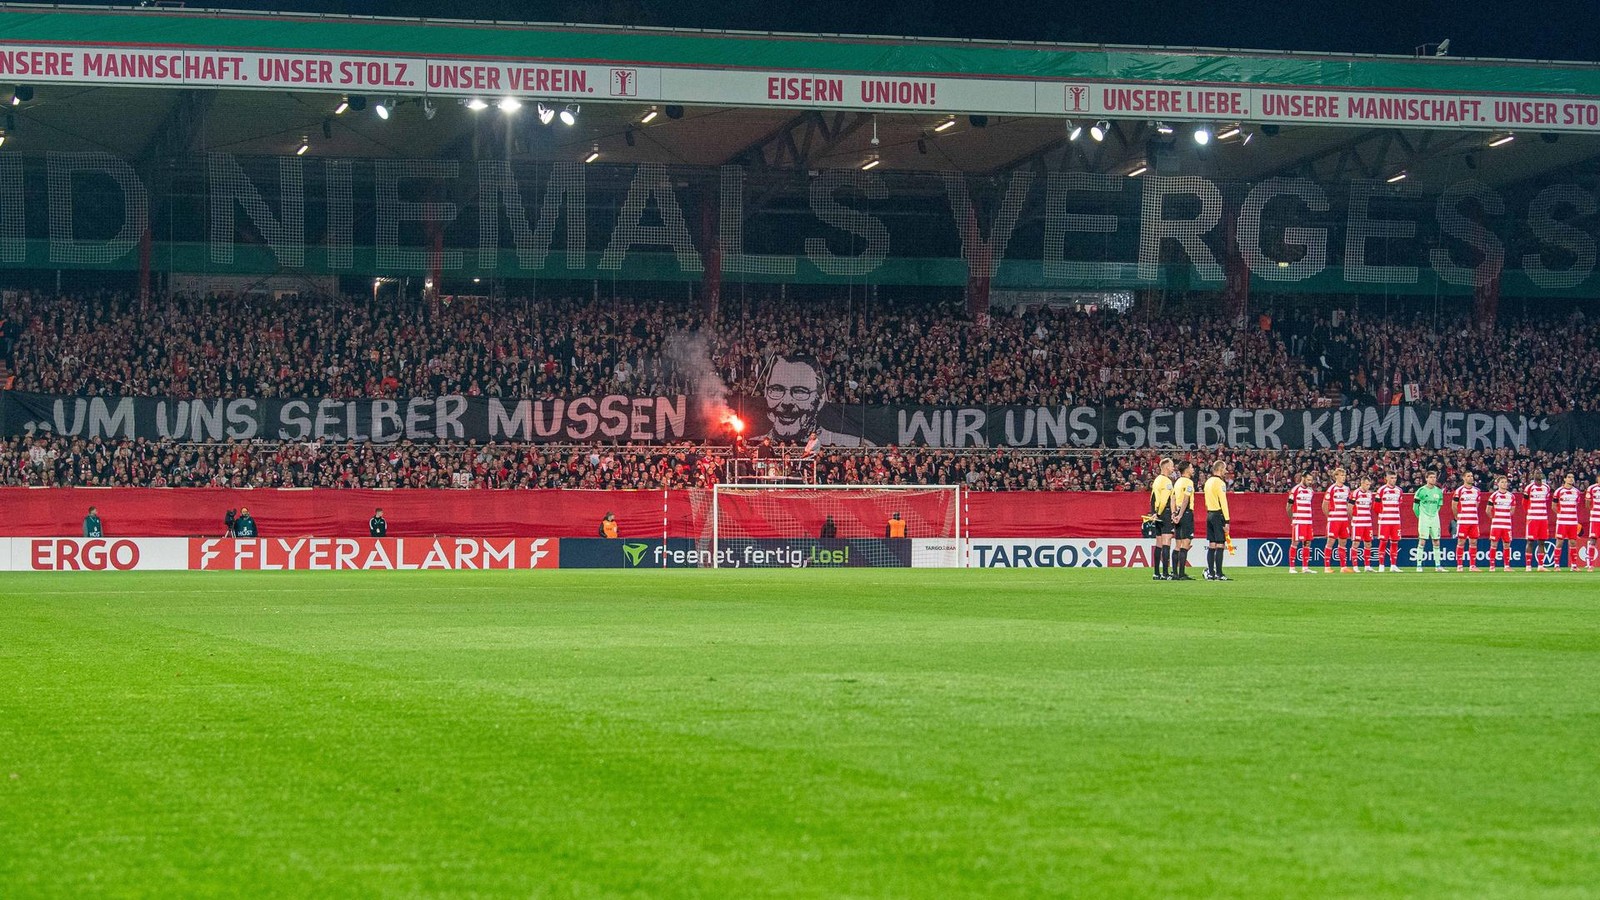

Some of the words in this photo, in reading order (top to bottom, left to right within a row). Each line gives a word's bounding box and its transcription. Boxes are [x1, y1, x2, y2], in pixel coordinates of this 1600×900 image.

[84, 53, 247, 81] MANNSCHAFT.
[258, 58, 333, 84] UNSER
[340, 61, 415, 87] STOLZ.
[428, 65, 500, 90] UNSER
[508, 67, 594, 94] VEREIN.
[768, 77, 843, 102] EISERN
[861, 80, 936, 105] UNION!
[1104, 89, 1182, 112] UNSERE
[1187, 92, 1249, 115] LIEBE.
[1262, 94, 1339, 118] UNSERE
[1348, 96, 1485, 122] MANNSCHAFT.
[1495, 102, 1558, 124] UNSER
[209, 151, 890, 276] NIEMALS
[156, 397, 258, 442] UNS
[279, 396, 467, 442] SELBER
[898, 408, 988, 448] WIR
[1005, 405, 1099, 448] UNS
[1116, 407, 1286, 450] SELBER
[31, 539, 140, 570] ERGO
[234, 538, 516, 570] FLYERALARM
[743, 546, 808, 568] fertig,
[811, 546, 849, 564] los!
[1107, 545, 1193, 568] BA
